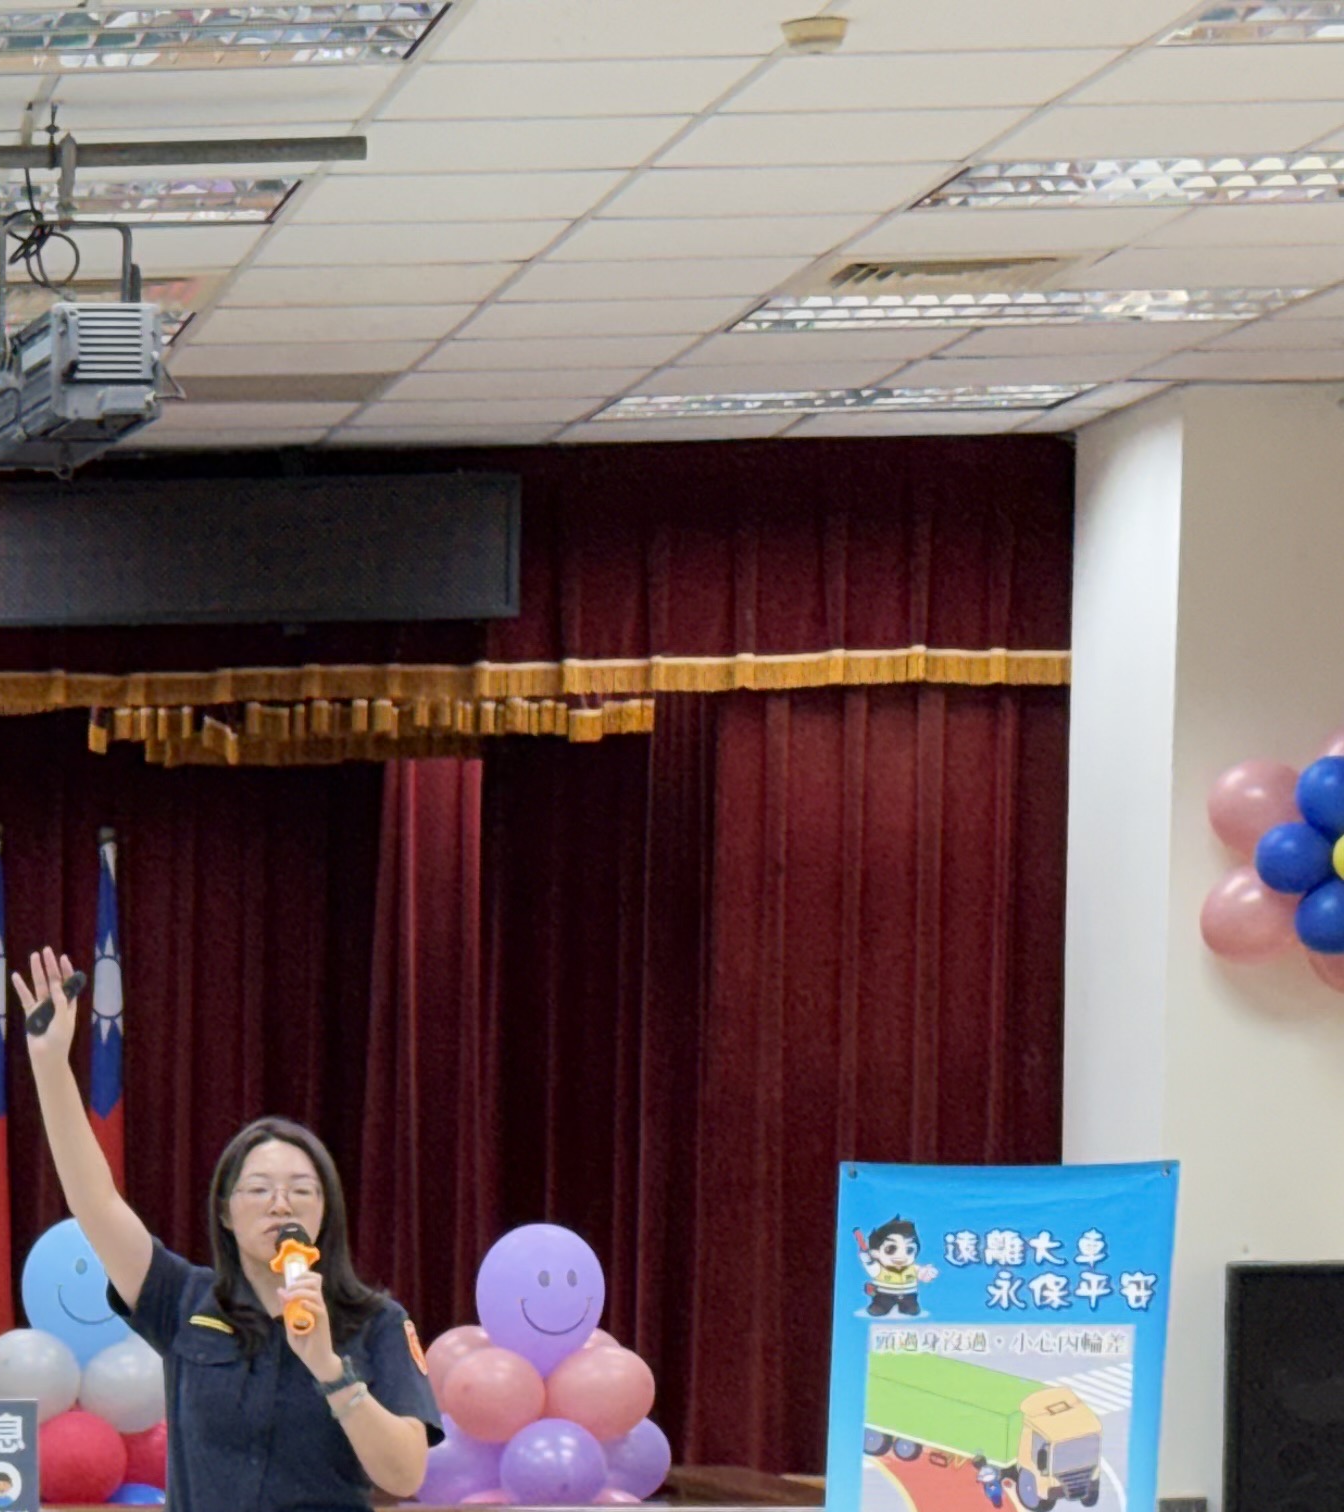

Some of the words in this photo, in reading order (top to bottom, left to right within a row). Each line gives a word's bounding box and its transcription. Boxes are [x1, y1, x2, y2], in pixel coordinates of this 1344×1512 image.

[944, 1228, 1109, 1268] 遠離大車
[985, 1269, 1158, 1312] 永保平安
